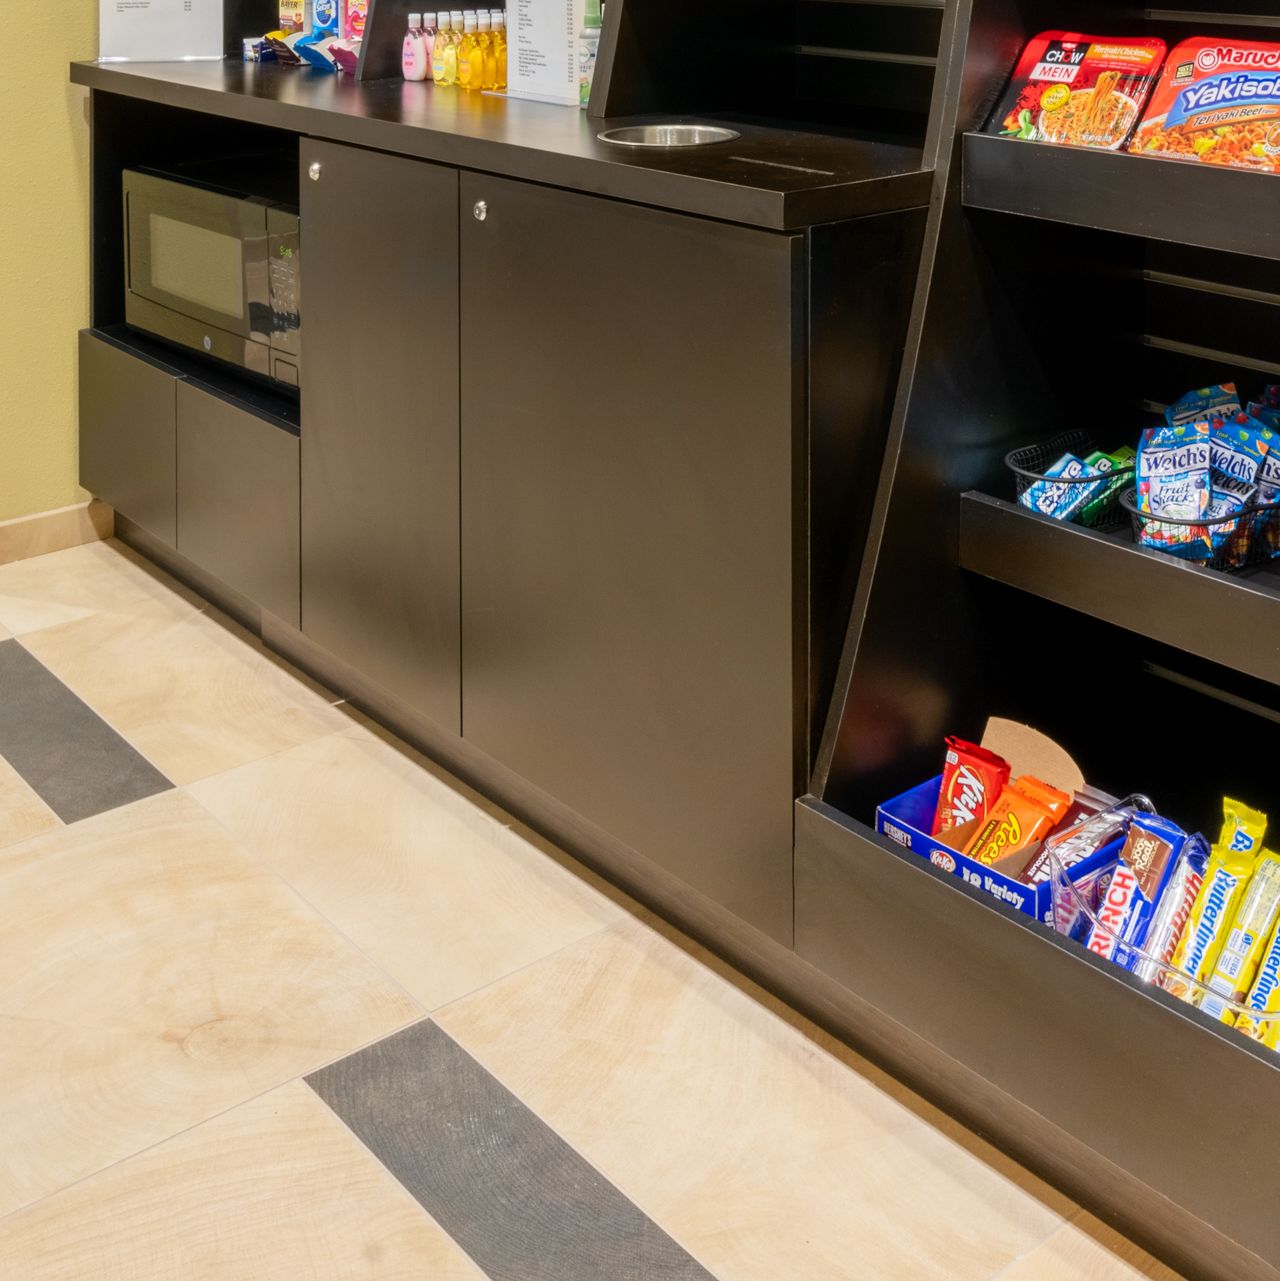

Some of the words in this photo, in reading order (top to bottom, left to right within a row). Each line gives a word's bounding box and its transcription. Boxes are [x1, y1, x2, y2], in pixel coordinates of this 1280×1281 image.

[281, 0, 298, 8] BAYER
[1046, 50, 1084, 63] CHOW
[1039, 66, 1073, 79] MEIN
[1194, 112, 1238, 127] Teriyaki
[1239, 107, 1262, 117] Beef
[1146, 447, 1207, 470] Welch's
[1209, 446, 1253, 481] Welch's
[1159, 482, 1191, 494] Fruit
[884, 822, 912, 846] HERSHEY'S
[1135, 839, 1155, 870] Real
[984, 877, 1024, 909] Variety
[1185, 868, 1237, 977] Butterfinger
